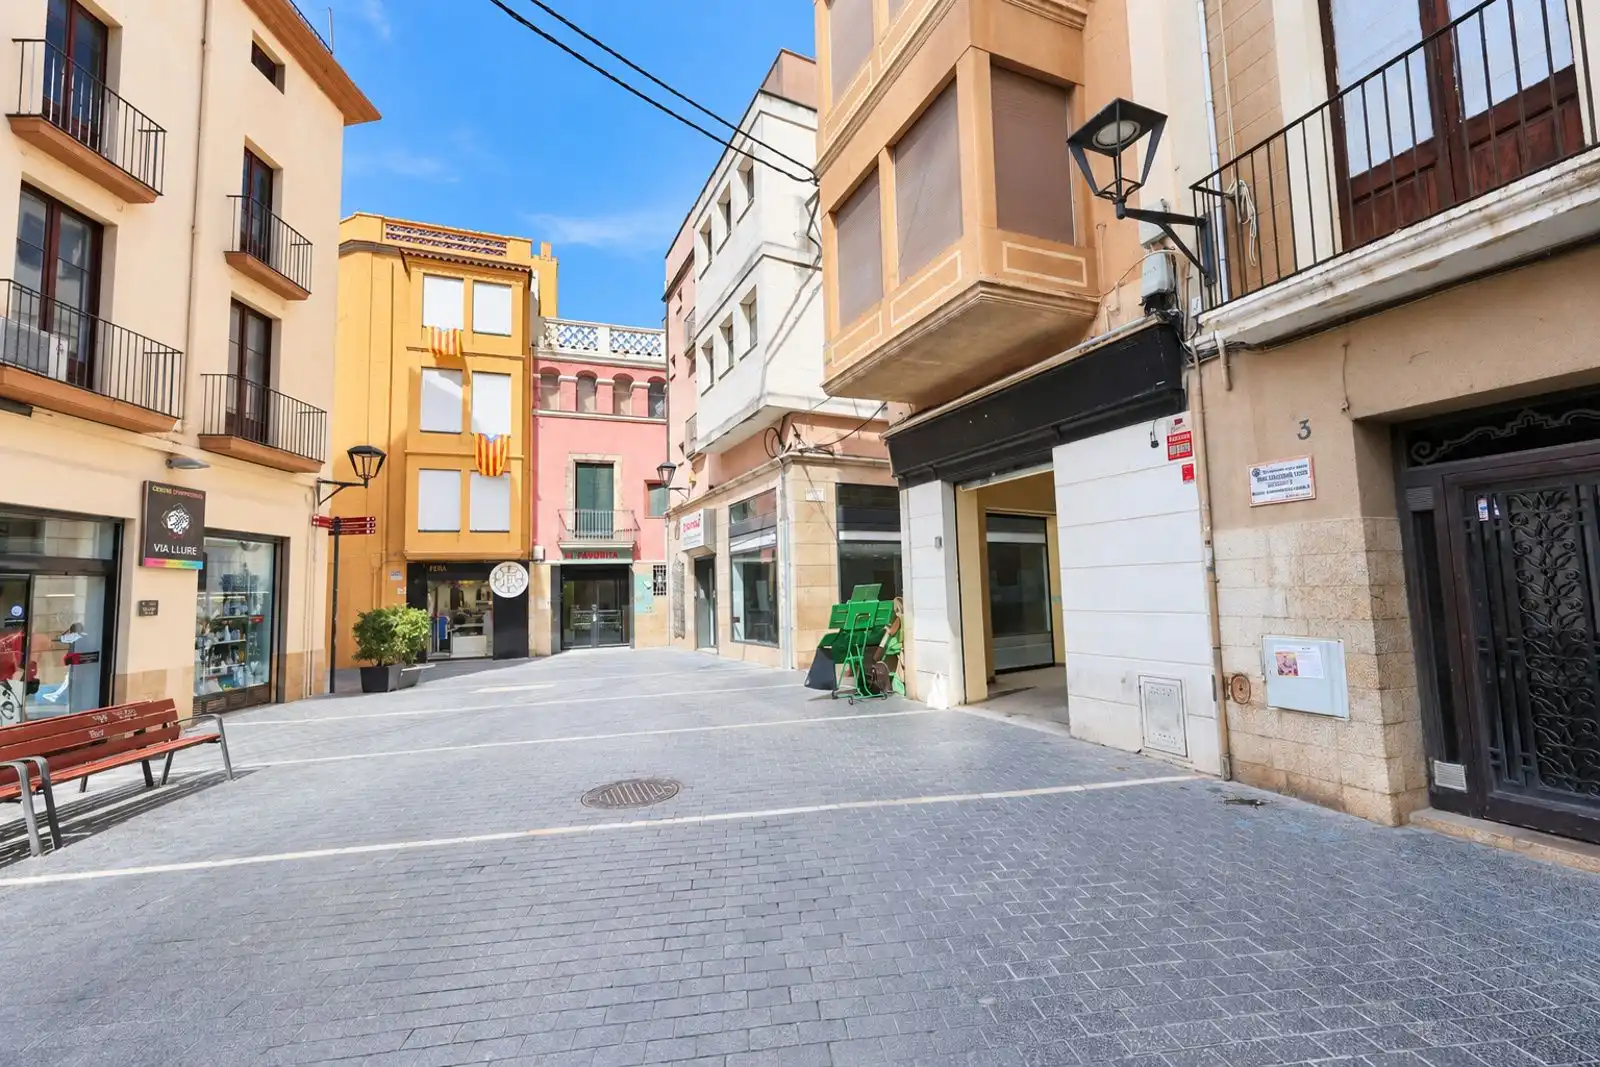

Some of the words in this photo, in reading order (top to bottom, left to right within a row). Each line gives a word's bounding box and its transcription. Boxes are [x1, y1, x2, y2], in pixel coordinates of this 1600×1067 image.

[1298, 418, 1311, 440] 3
[153, 543, 170, 553] VIA
[171, 545, 198, 556] LLURE
